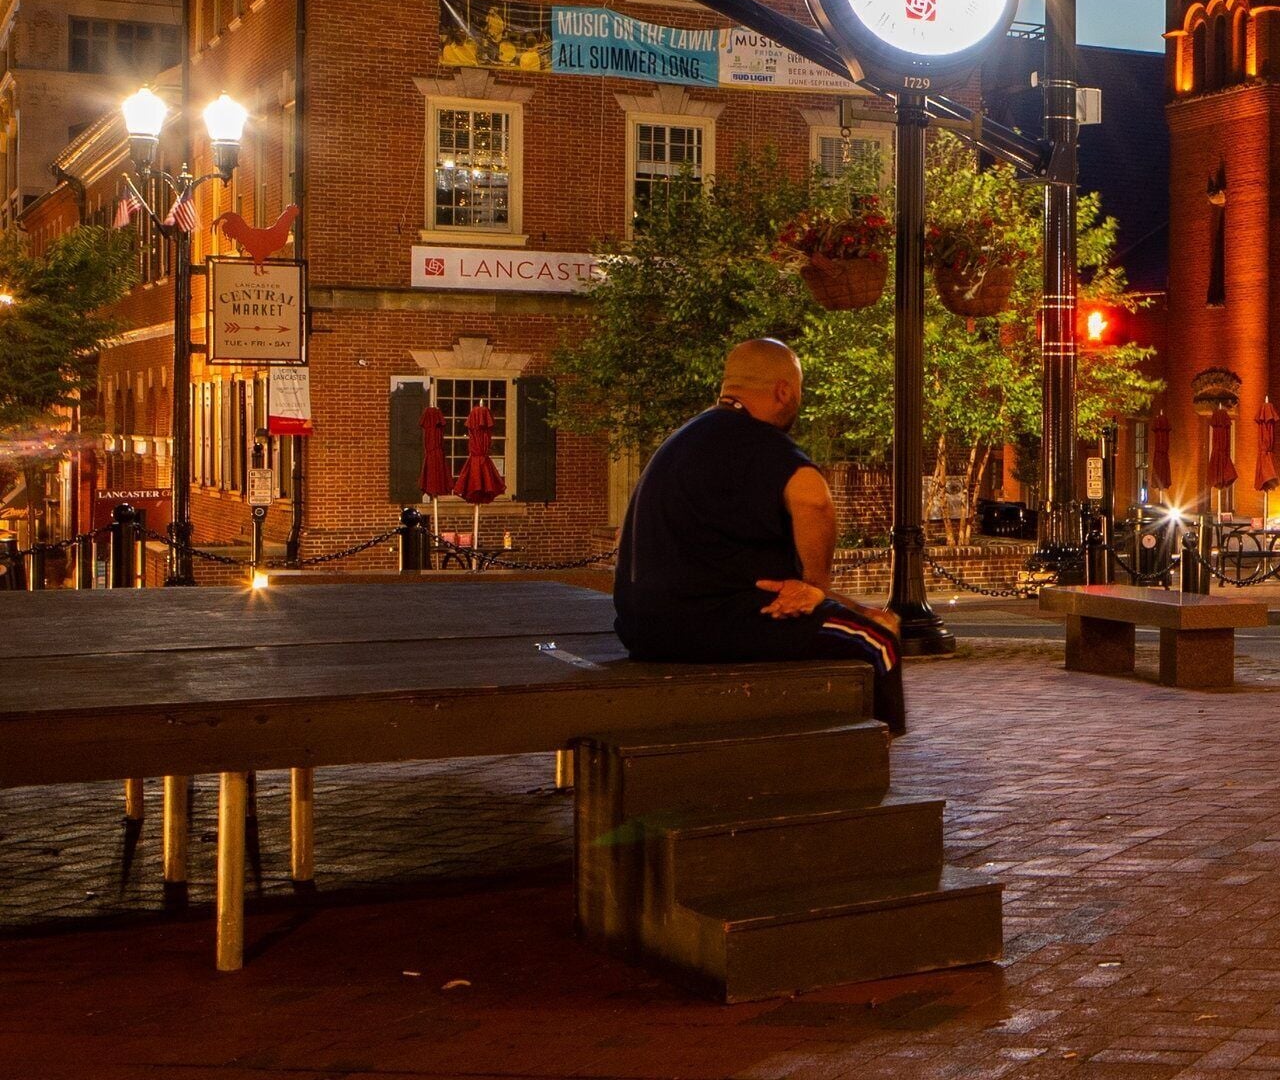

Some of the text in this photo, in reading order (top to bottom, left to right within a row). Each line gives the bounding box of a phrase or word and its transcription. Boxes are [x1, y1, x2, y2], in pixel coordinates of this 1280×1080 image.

[558, 11, 609, 38] MUSIC
[613, 16, 634, 41] ON
[638, 21, 666, 46] THE
[558, 43, 585, 69] ALL
[589, 45, 656, 75] SUMMER
[732, 73, 773, 82] BUD LIGHT
[788, 68, 807, 76] BEER
[903, 76, 931, 90] 1729
[459, 258, 600, 281] LANCASTE
[219, 288, 296, 307] CENTRAL
[232, 303, 283, 317] MARKET
[274, 340, 291, 348] SAT
[98, 490, 160, 499] LANCASTER
